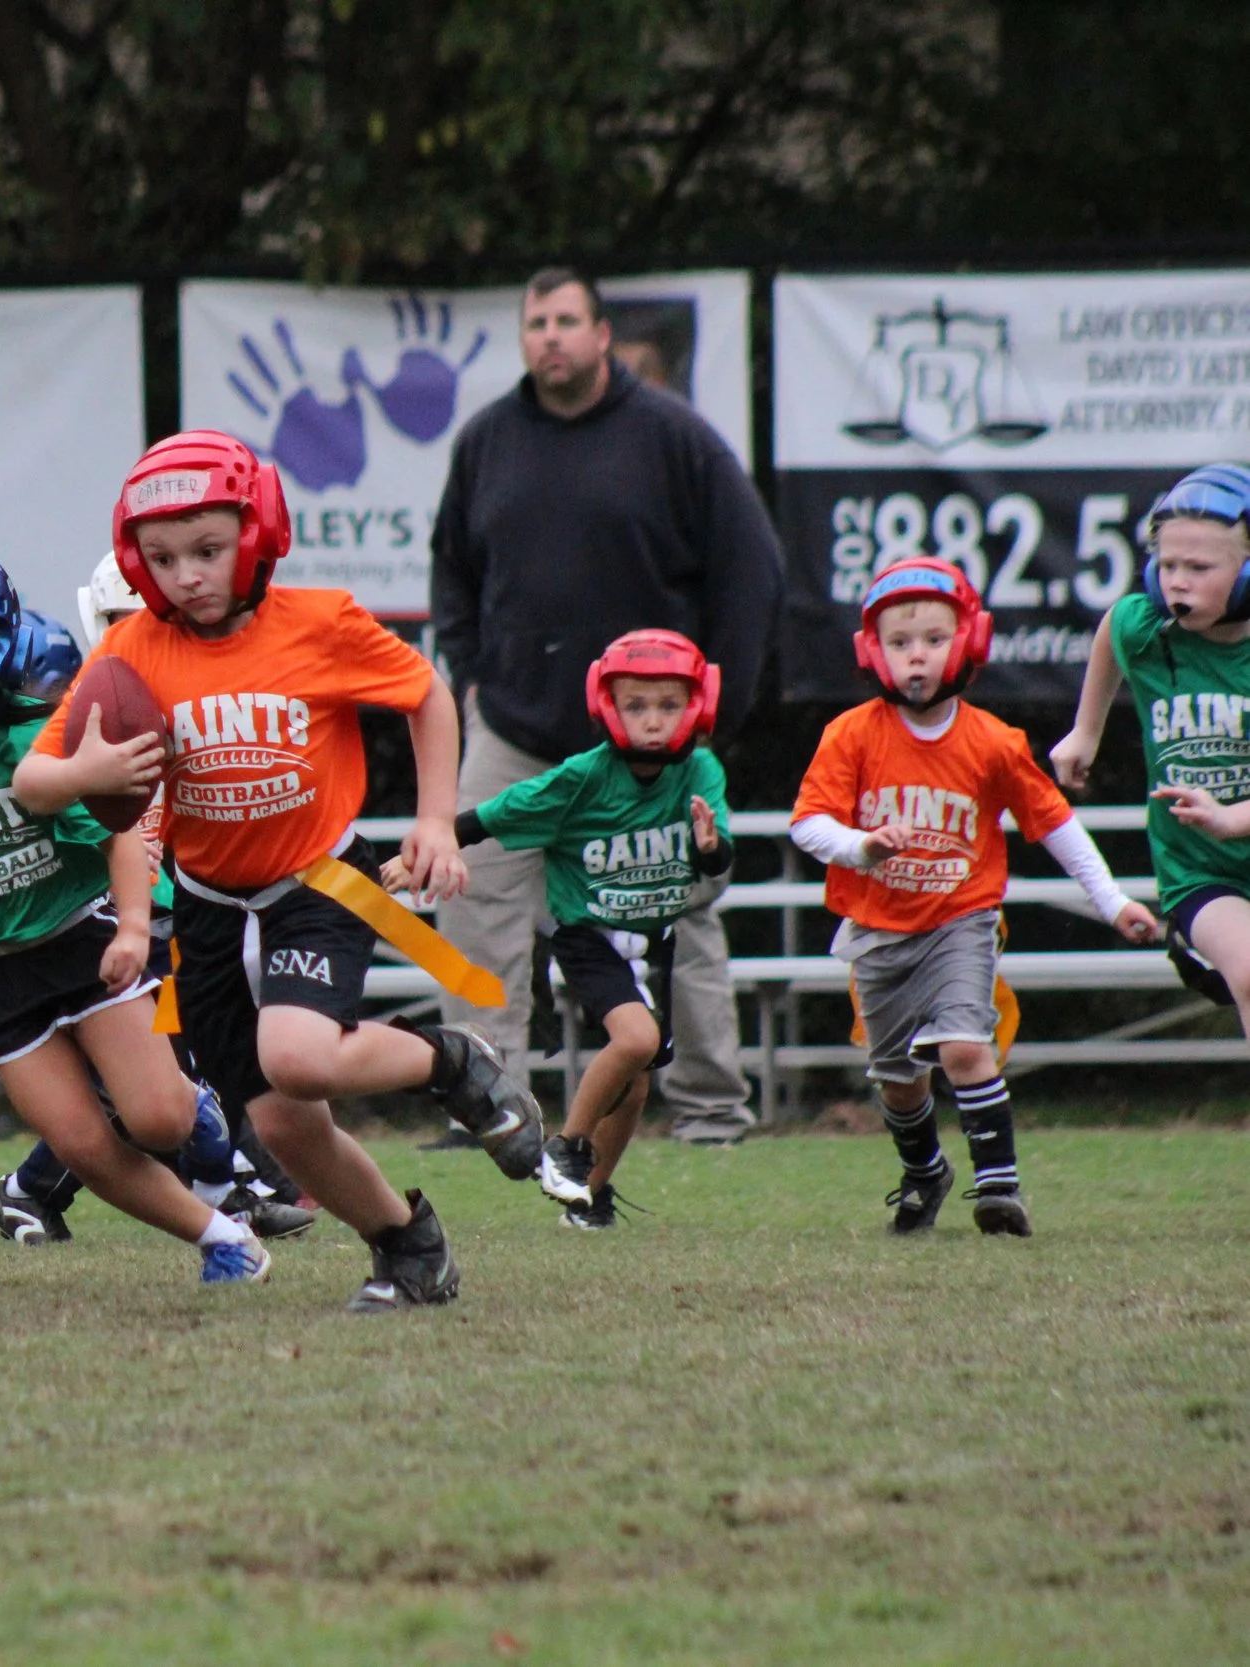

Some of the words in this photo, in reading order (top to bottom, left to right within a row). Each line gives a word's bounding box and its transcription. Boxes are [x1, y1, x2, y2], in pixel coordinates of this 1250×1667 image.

[874, 493, 1150, 611] 882.5
[172, 692, 310, 753] AINTS
[180, 777, 294, 803] FOOTBALL
[206, 808, 245, 821] DAME
[250, 788, 317, 820] ACADEMY
[583, 820, 689, 874] SAINT
[13, 858, 64, 890] ACADEM
[268, 949, 333, 986] SNA
